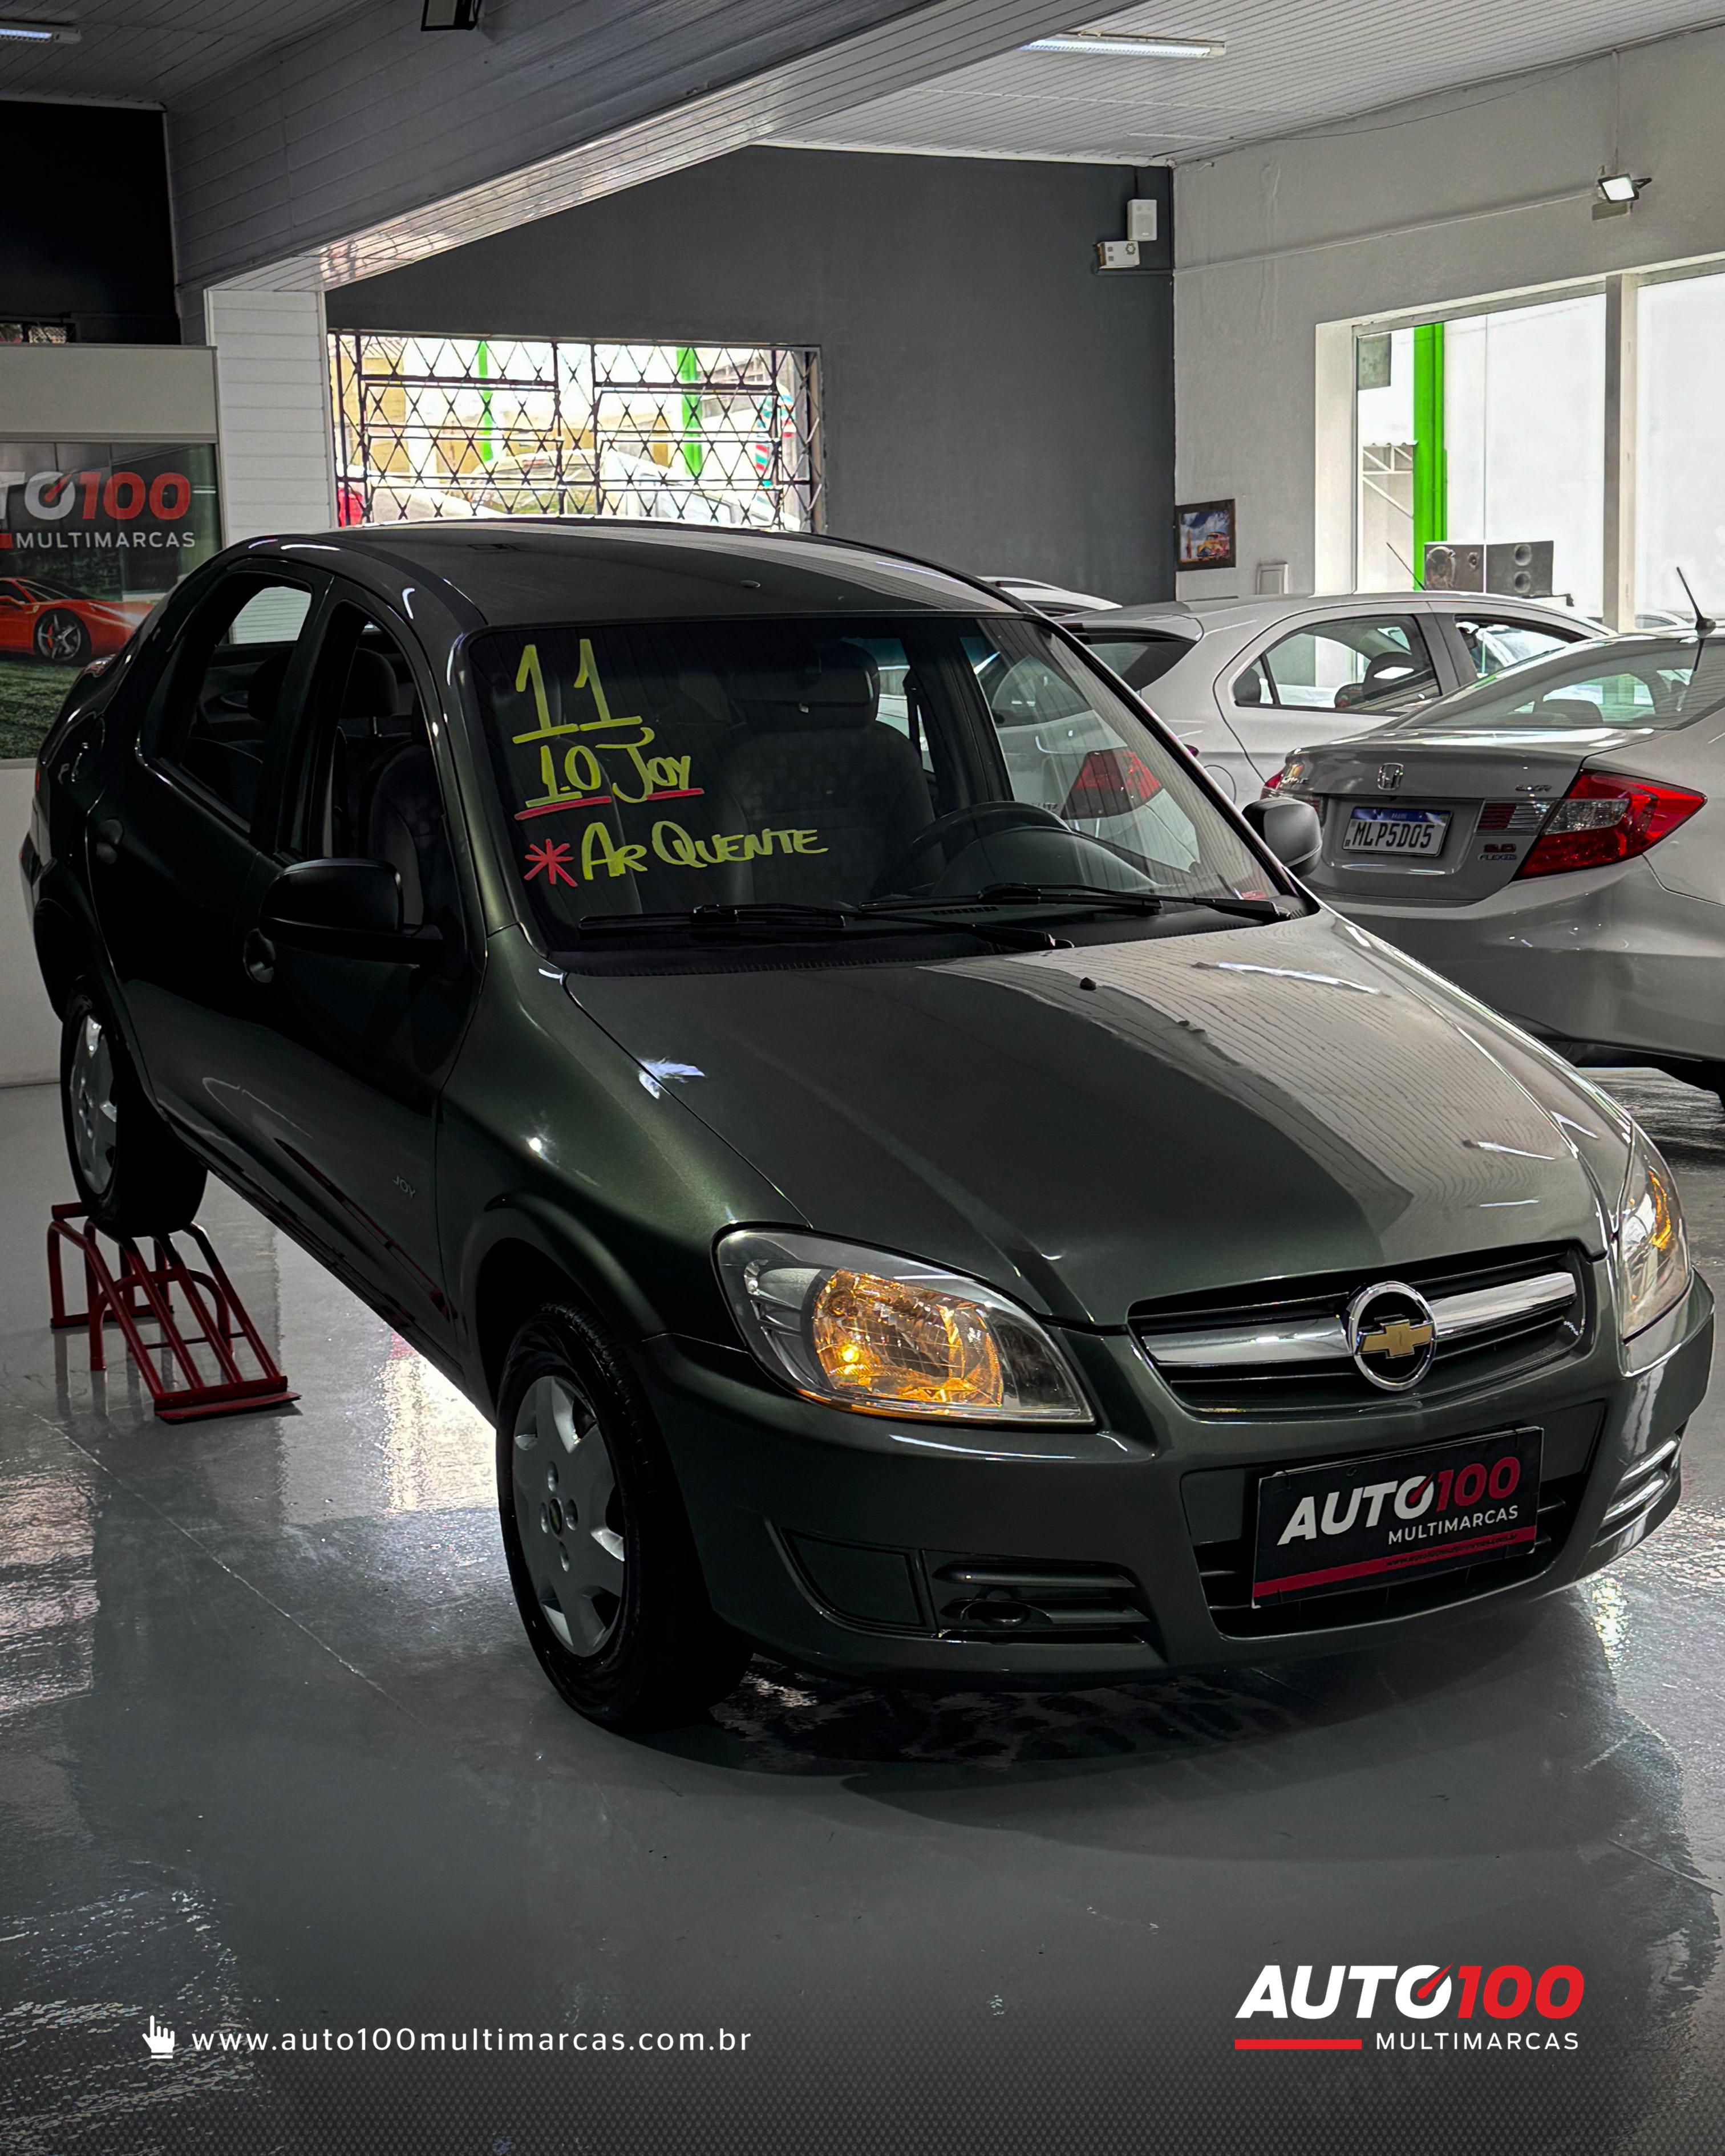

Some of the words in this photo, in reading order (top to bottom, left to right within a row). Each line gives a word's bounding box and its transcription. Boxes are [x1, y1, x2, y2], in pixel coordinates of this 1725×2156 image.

[16, 532, 196, 548] MULTIMARCAS
[651, 820, 829, 868] QUENTE
[1352, 821, 1435, 848] MLP5D05
[392, 1174, 416, 1198] JOY
[1277, 1456, 1521, 1545] AUTO100
[1388, 1505, 1519, 1545] MULTIMARCAS
